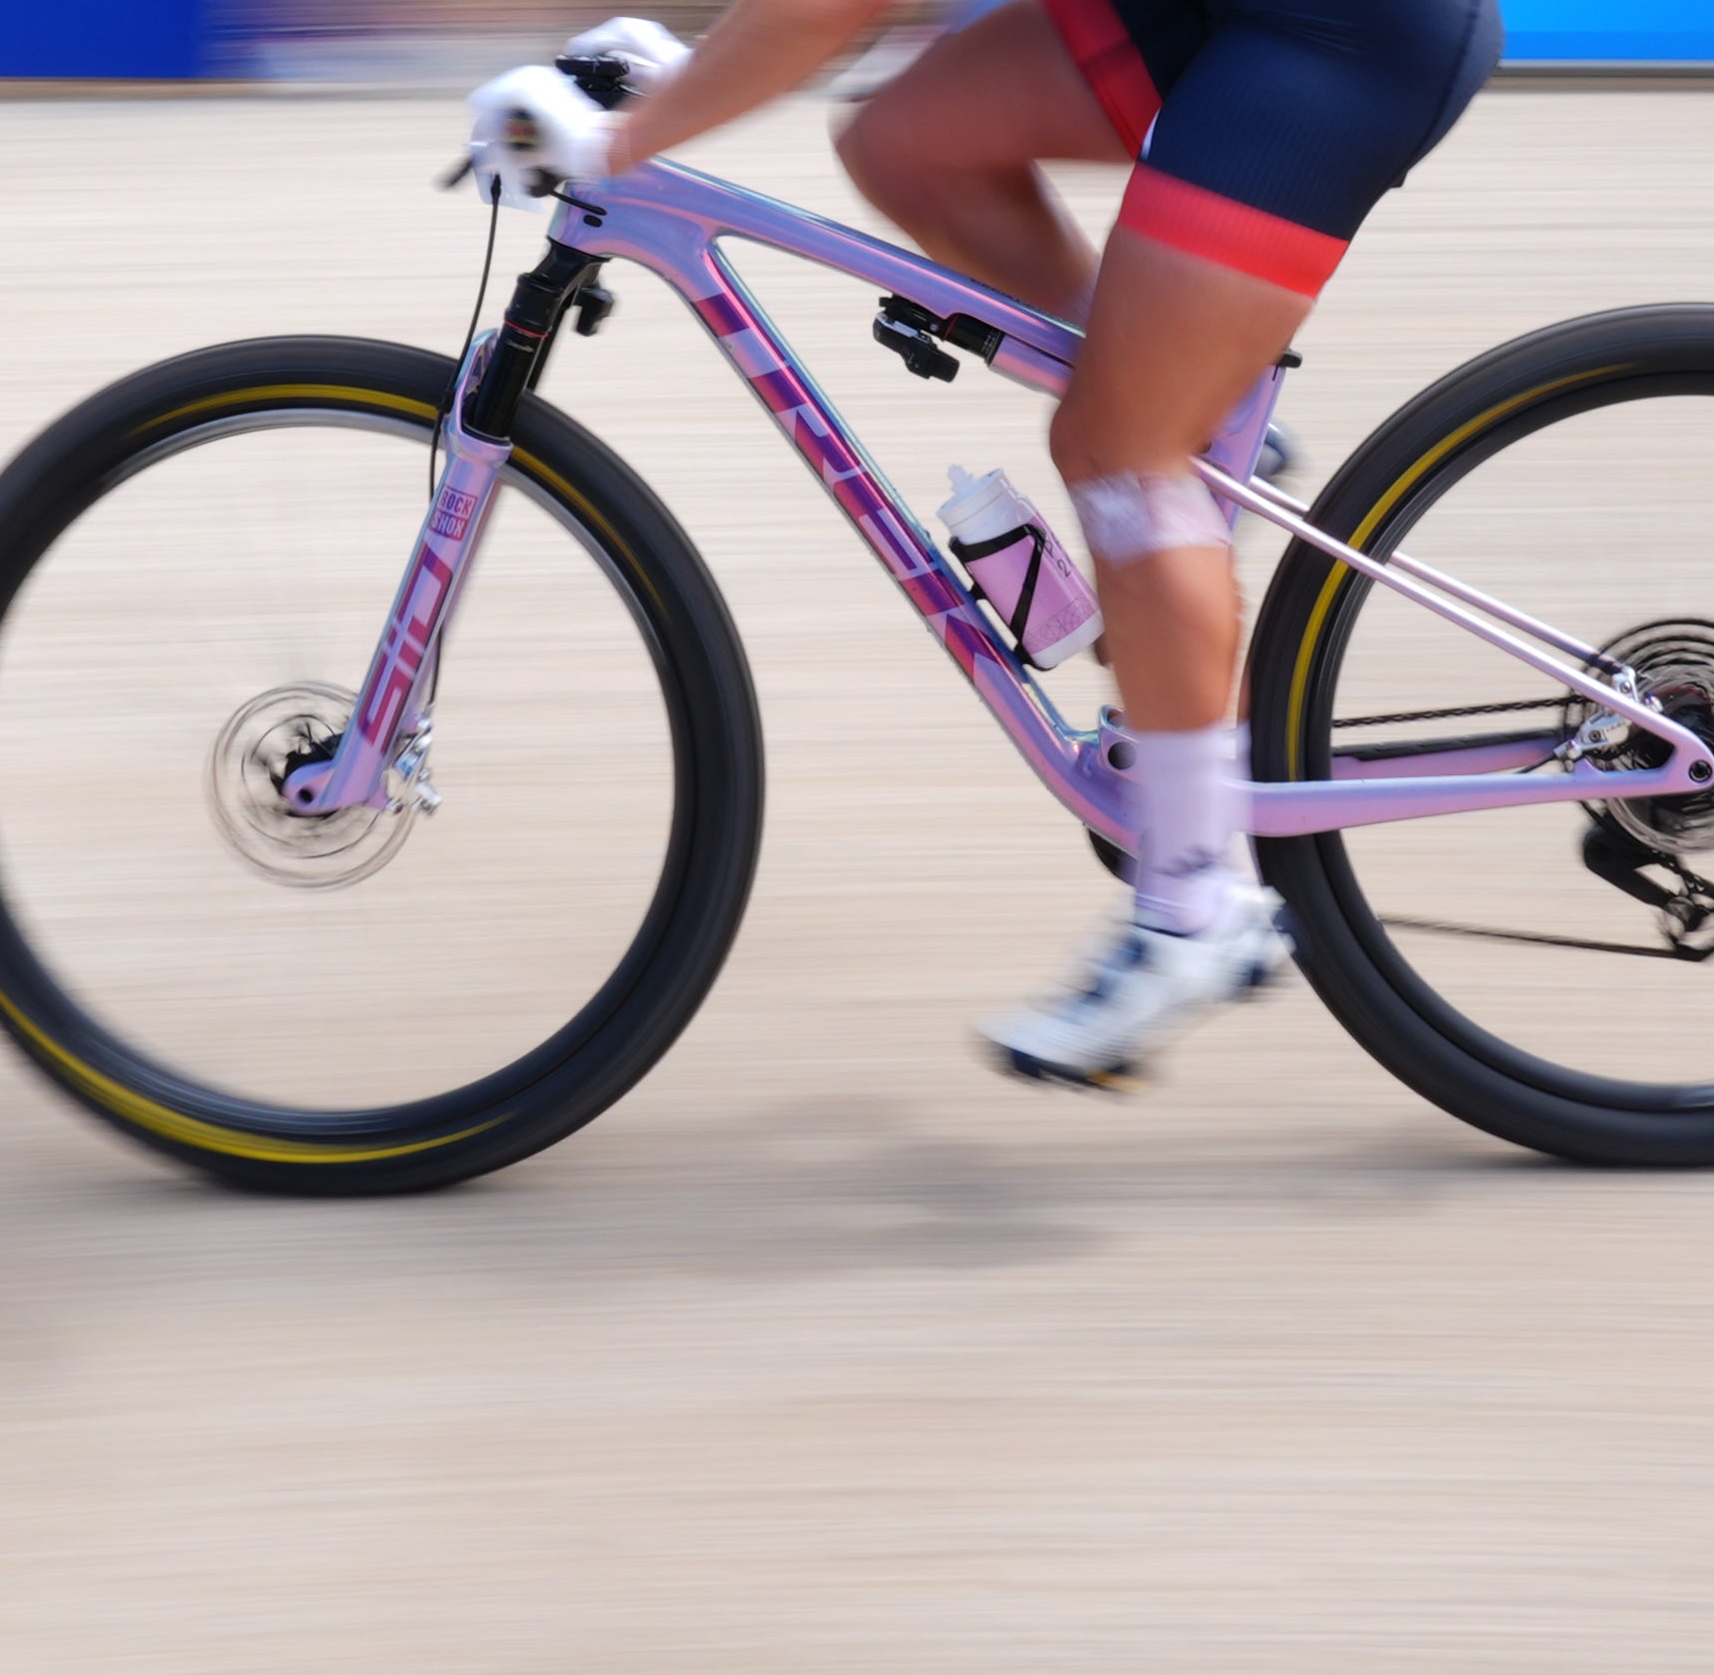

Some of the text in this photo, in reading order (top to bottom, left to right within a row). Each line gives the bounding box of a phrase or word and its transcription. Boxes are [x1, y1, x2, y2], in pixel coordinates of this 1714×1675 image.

[431, 511, 467, 539] SHOX
[439, 489, 474, 516] ROCK
[690, 251, 1015, 684] TREK
[357, 539, 453, 756] SID
